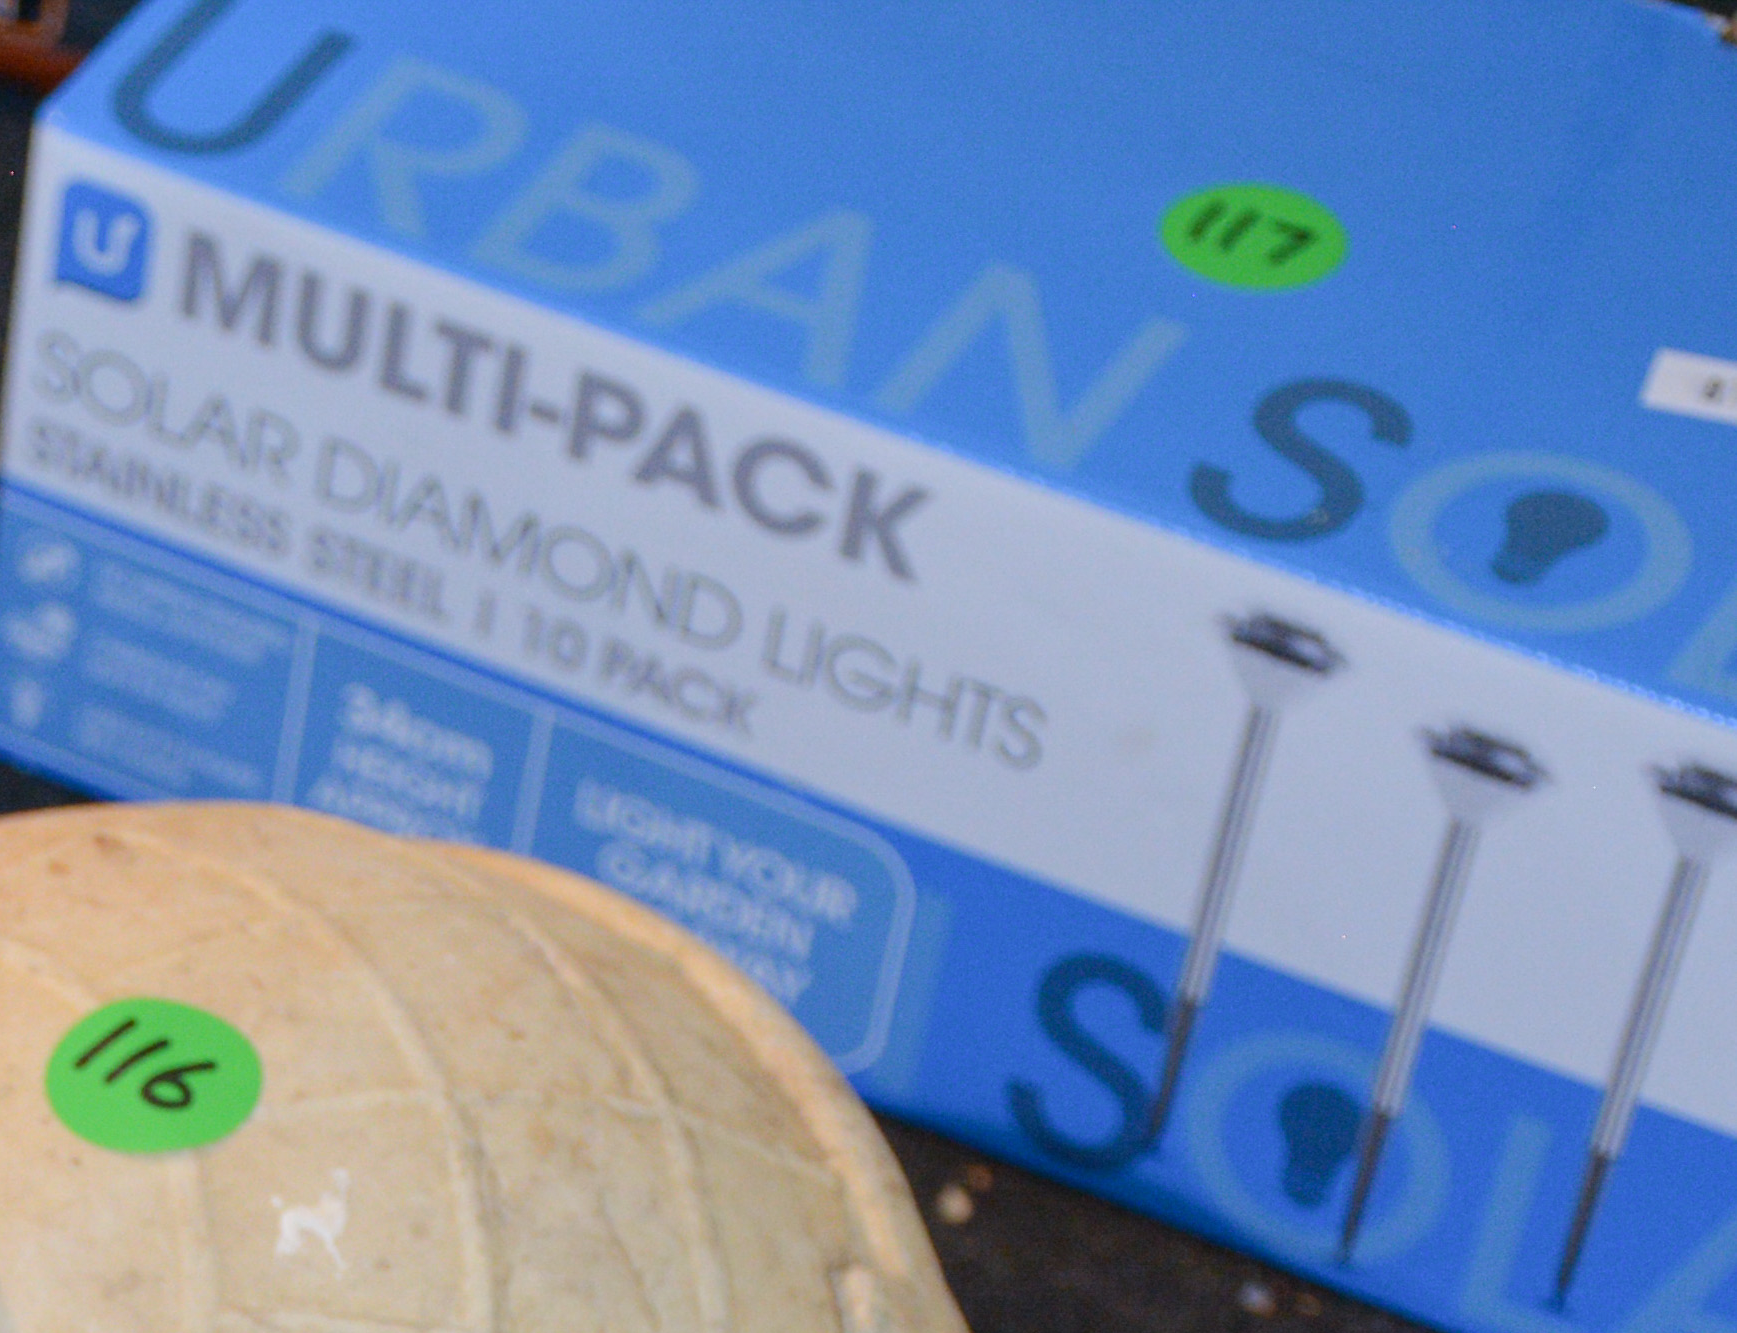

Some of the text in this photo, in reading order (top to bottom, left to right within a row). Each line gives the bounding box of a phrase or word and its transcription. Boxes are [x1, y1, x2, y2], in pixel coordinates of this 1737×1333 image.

[111, 0, 1189, 472] URBAN
[1185, 198, 1319, 268] 117
[31, 328, 302, 487] SOLAR
[315, 435, 744, 651] DIAMOND
[762, 607, 1048, 771] LIGHTS
[180, 228, 931, 584] MULTI-PACK
[29, 417, 292, 559] STAINLESS
[306, 524, 450, 626] STEEL
[526, 607, 588, 674] 10
[596, 634, 757, 739] PACK
[75, 1018, 216, 1110] 116
